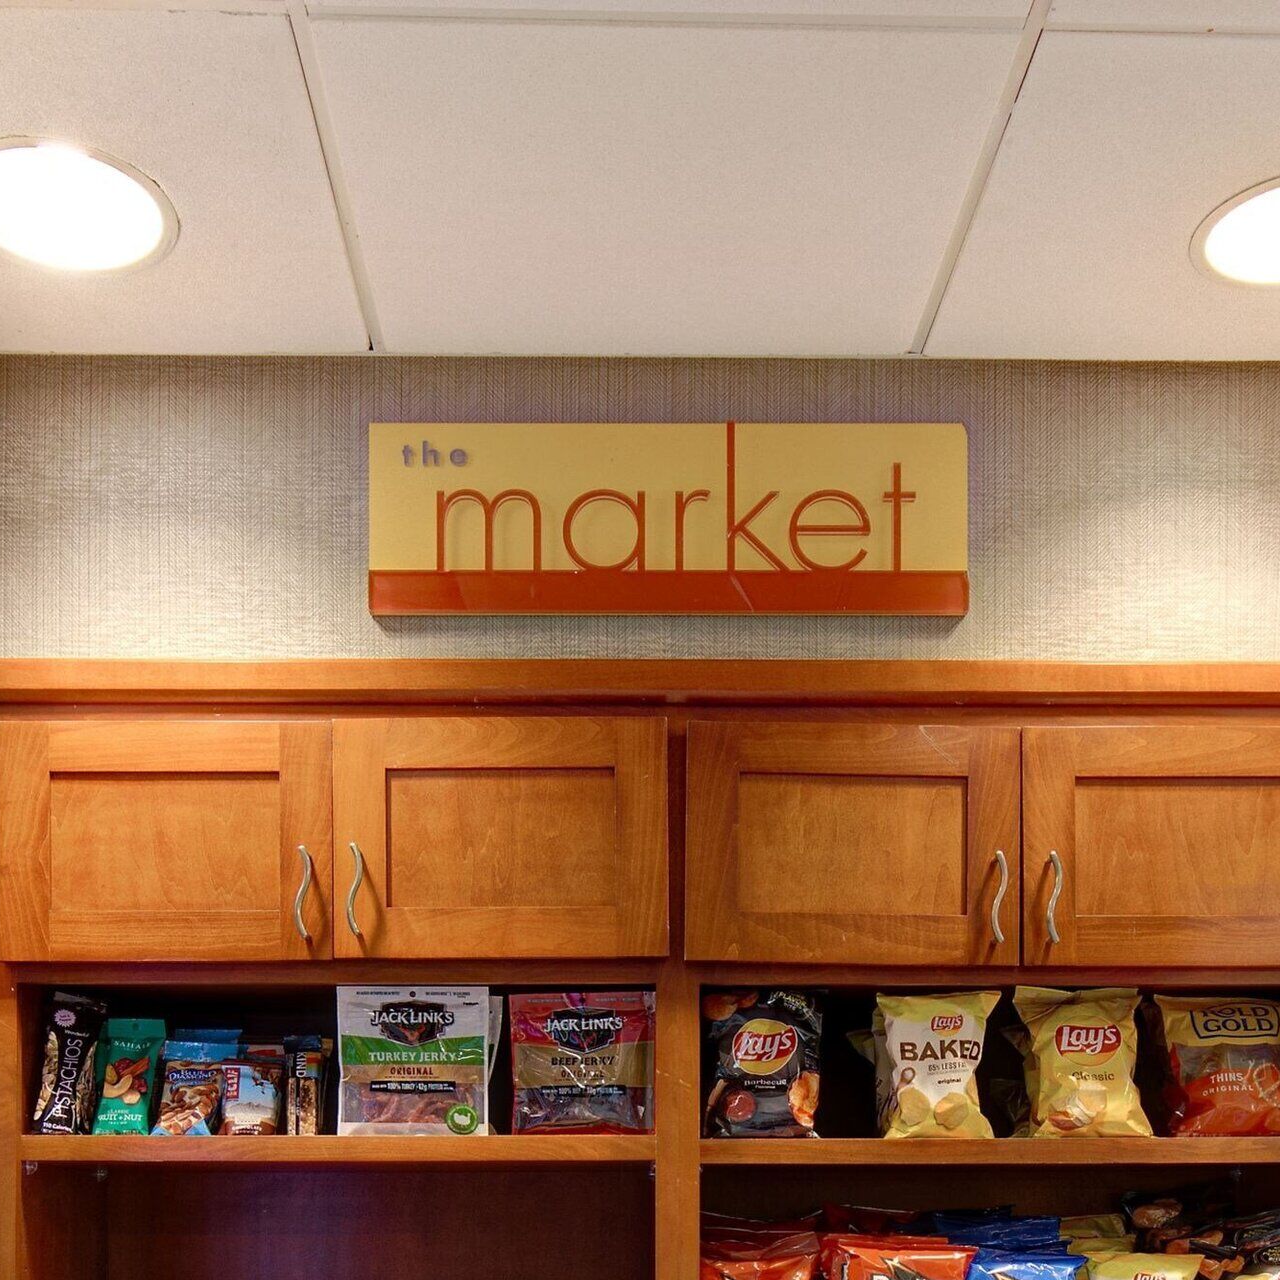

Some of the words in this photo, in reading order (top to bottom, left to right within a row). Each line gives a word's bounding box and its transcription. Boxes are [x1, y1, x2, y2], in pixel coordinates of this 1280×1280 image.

[401, 439, 469, 469] the
[436, 420, 917, 572] market
[371, 1009, 410, 1025] JACK
[932, 1015, 963, 1031] Lay's
[544, 1019, 580, 1032] JACK
[1202, 1018, 1274, 1033] GOLD
[737, 1028, 792, 1062] Lay's
[1061, 1024, 1118, 1055] Lay's
[369, 1052, 417, 1062] TURKEY
[419, 1052, 456, 1062] JERKY
[900, 1040, 981, 1062] BAKED
[296, 1052, 307, 1078] KIND
[390, 1067, 434, 1075] ORIGINAL
[52, 1038, 83, 1118] PISTACHIOS
[169, 1071, 216, 1080] DIAMOND
[937, 1077, 962, 1085] original
[1072, 1071, 1115, 1081] Classic
[1210, 1072, 1244, 1084] THINS
[1202, 1084, 1254, 1097] ORIGINAL
